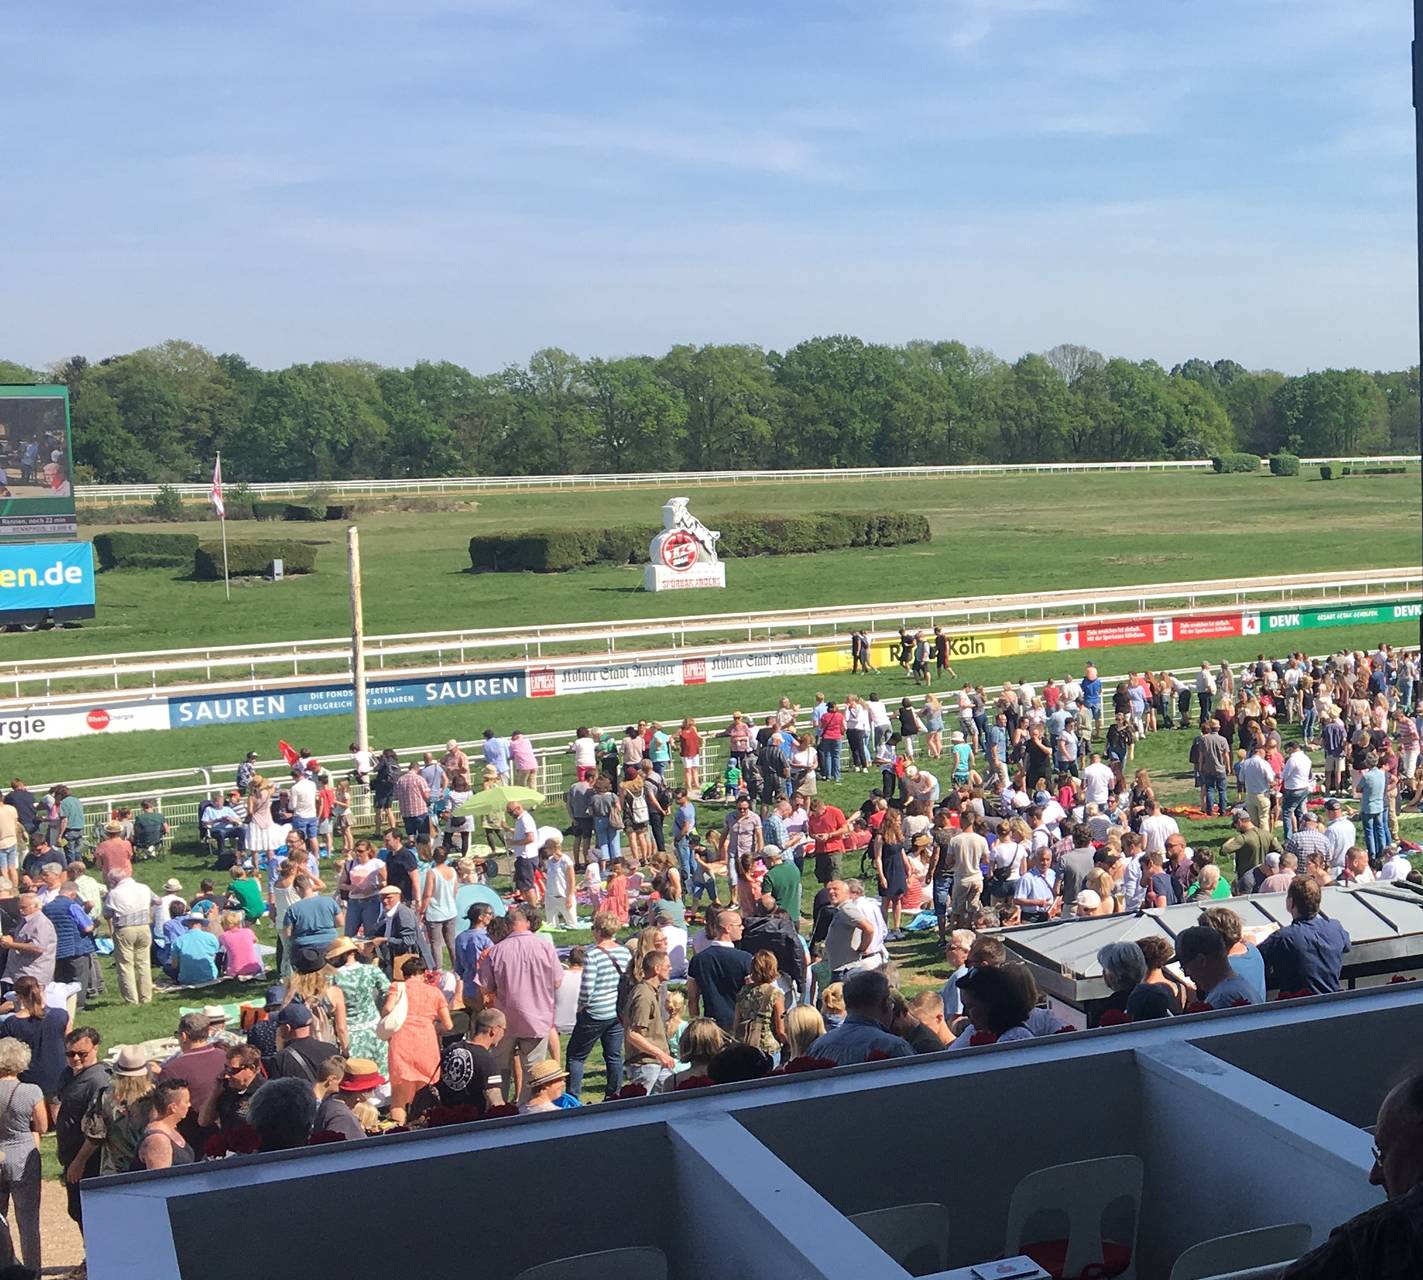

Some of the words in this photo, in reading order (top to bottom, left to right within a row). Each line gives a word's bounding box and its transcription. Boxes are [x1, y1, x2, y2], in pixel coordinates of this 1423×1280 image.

[0, 561, 82, 587] en.de
[1394, 605, 1423, 617] DEVK
[1269, 614, 1300, 628] DEVK
[948, 637, 985, 655] Köln
[426, 677, 518, 701] SAUREN
[531, 675, 554, 690] EXPRESS
[298, 701, 353, 712] ERFOLGREICH
[384, 695, 414, 704] JAHREN
[310, 691, 324, 700] DIE
[180, 695, 285, 721] SAUREN
